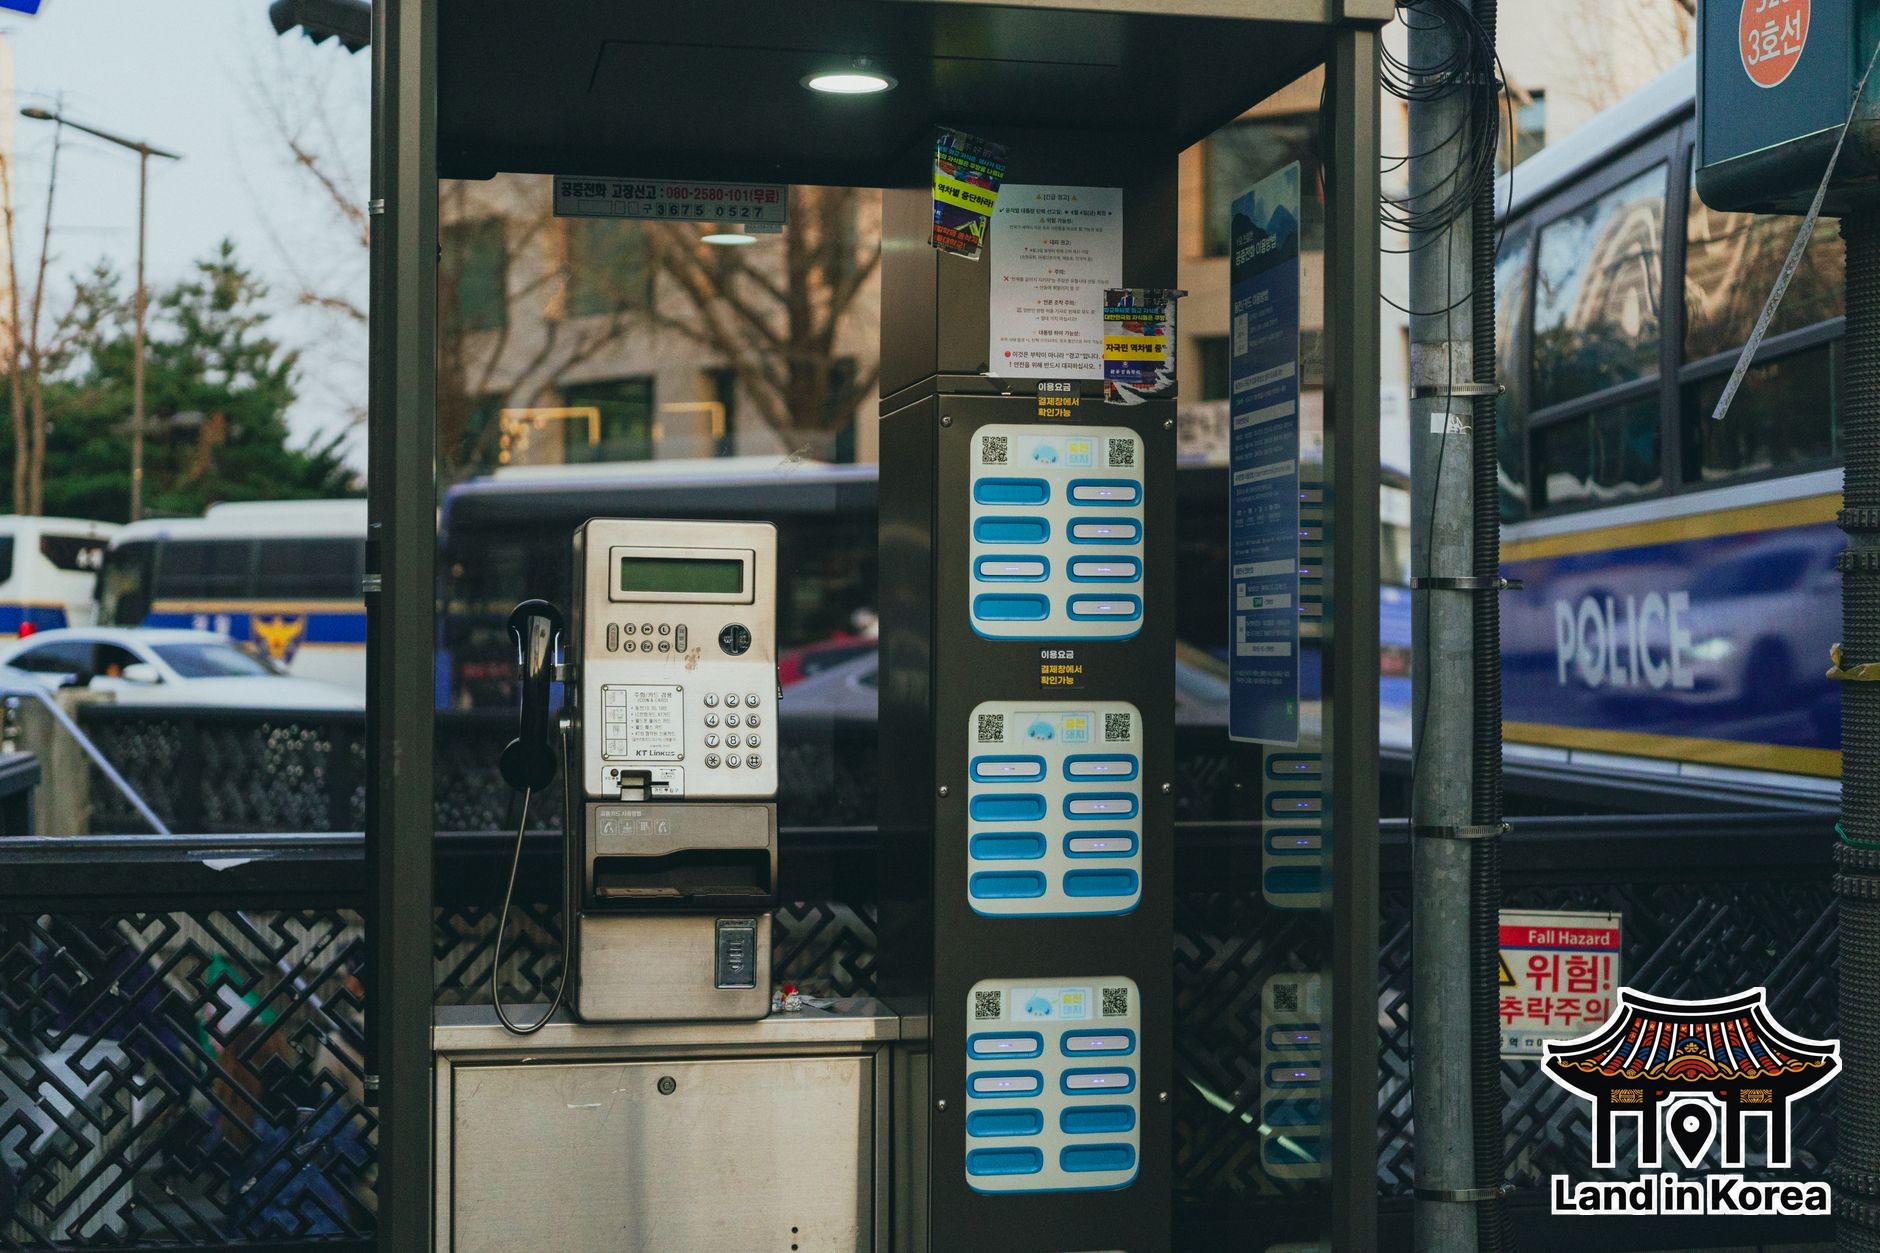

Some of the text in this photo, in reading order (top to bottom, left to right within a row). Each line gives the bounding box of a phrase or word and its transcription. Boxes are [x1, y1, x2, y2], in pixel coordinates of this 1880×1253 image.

[1748, 10, 1800, 65] 3호선
[561, 182, 607, 198] 공중전화
[1106, 344, 1128, 352] 자국민
[1130, 344, 1153, 352] 역차별
[1038, 383, 1071, 391] 이용요금
[1555, 591, 1694, 689] POLICE
[1041, 650, 1074, 659] 이용요금
[710, 696, 756, 704] 1 2 3
[709, 716, 757, 724] 4 5 6
[710, 736, 757, 745] 7 8 9
[730, 756, 737, 765] 0
[1529, 930, 1610, 945] Fall Hazard
[1526, 954, 1611, 993] 위험!
[1500, 997, 1610, 1026] 추락주의
